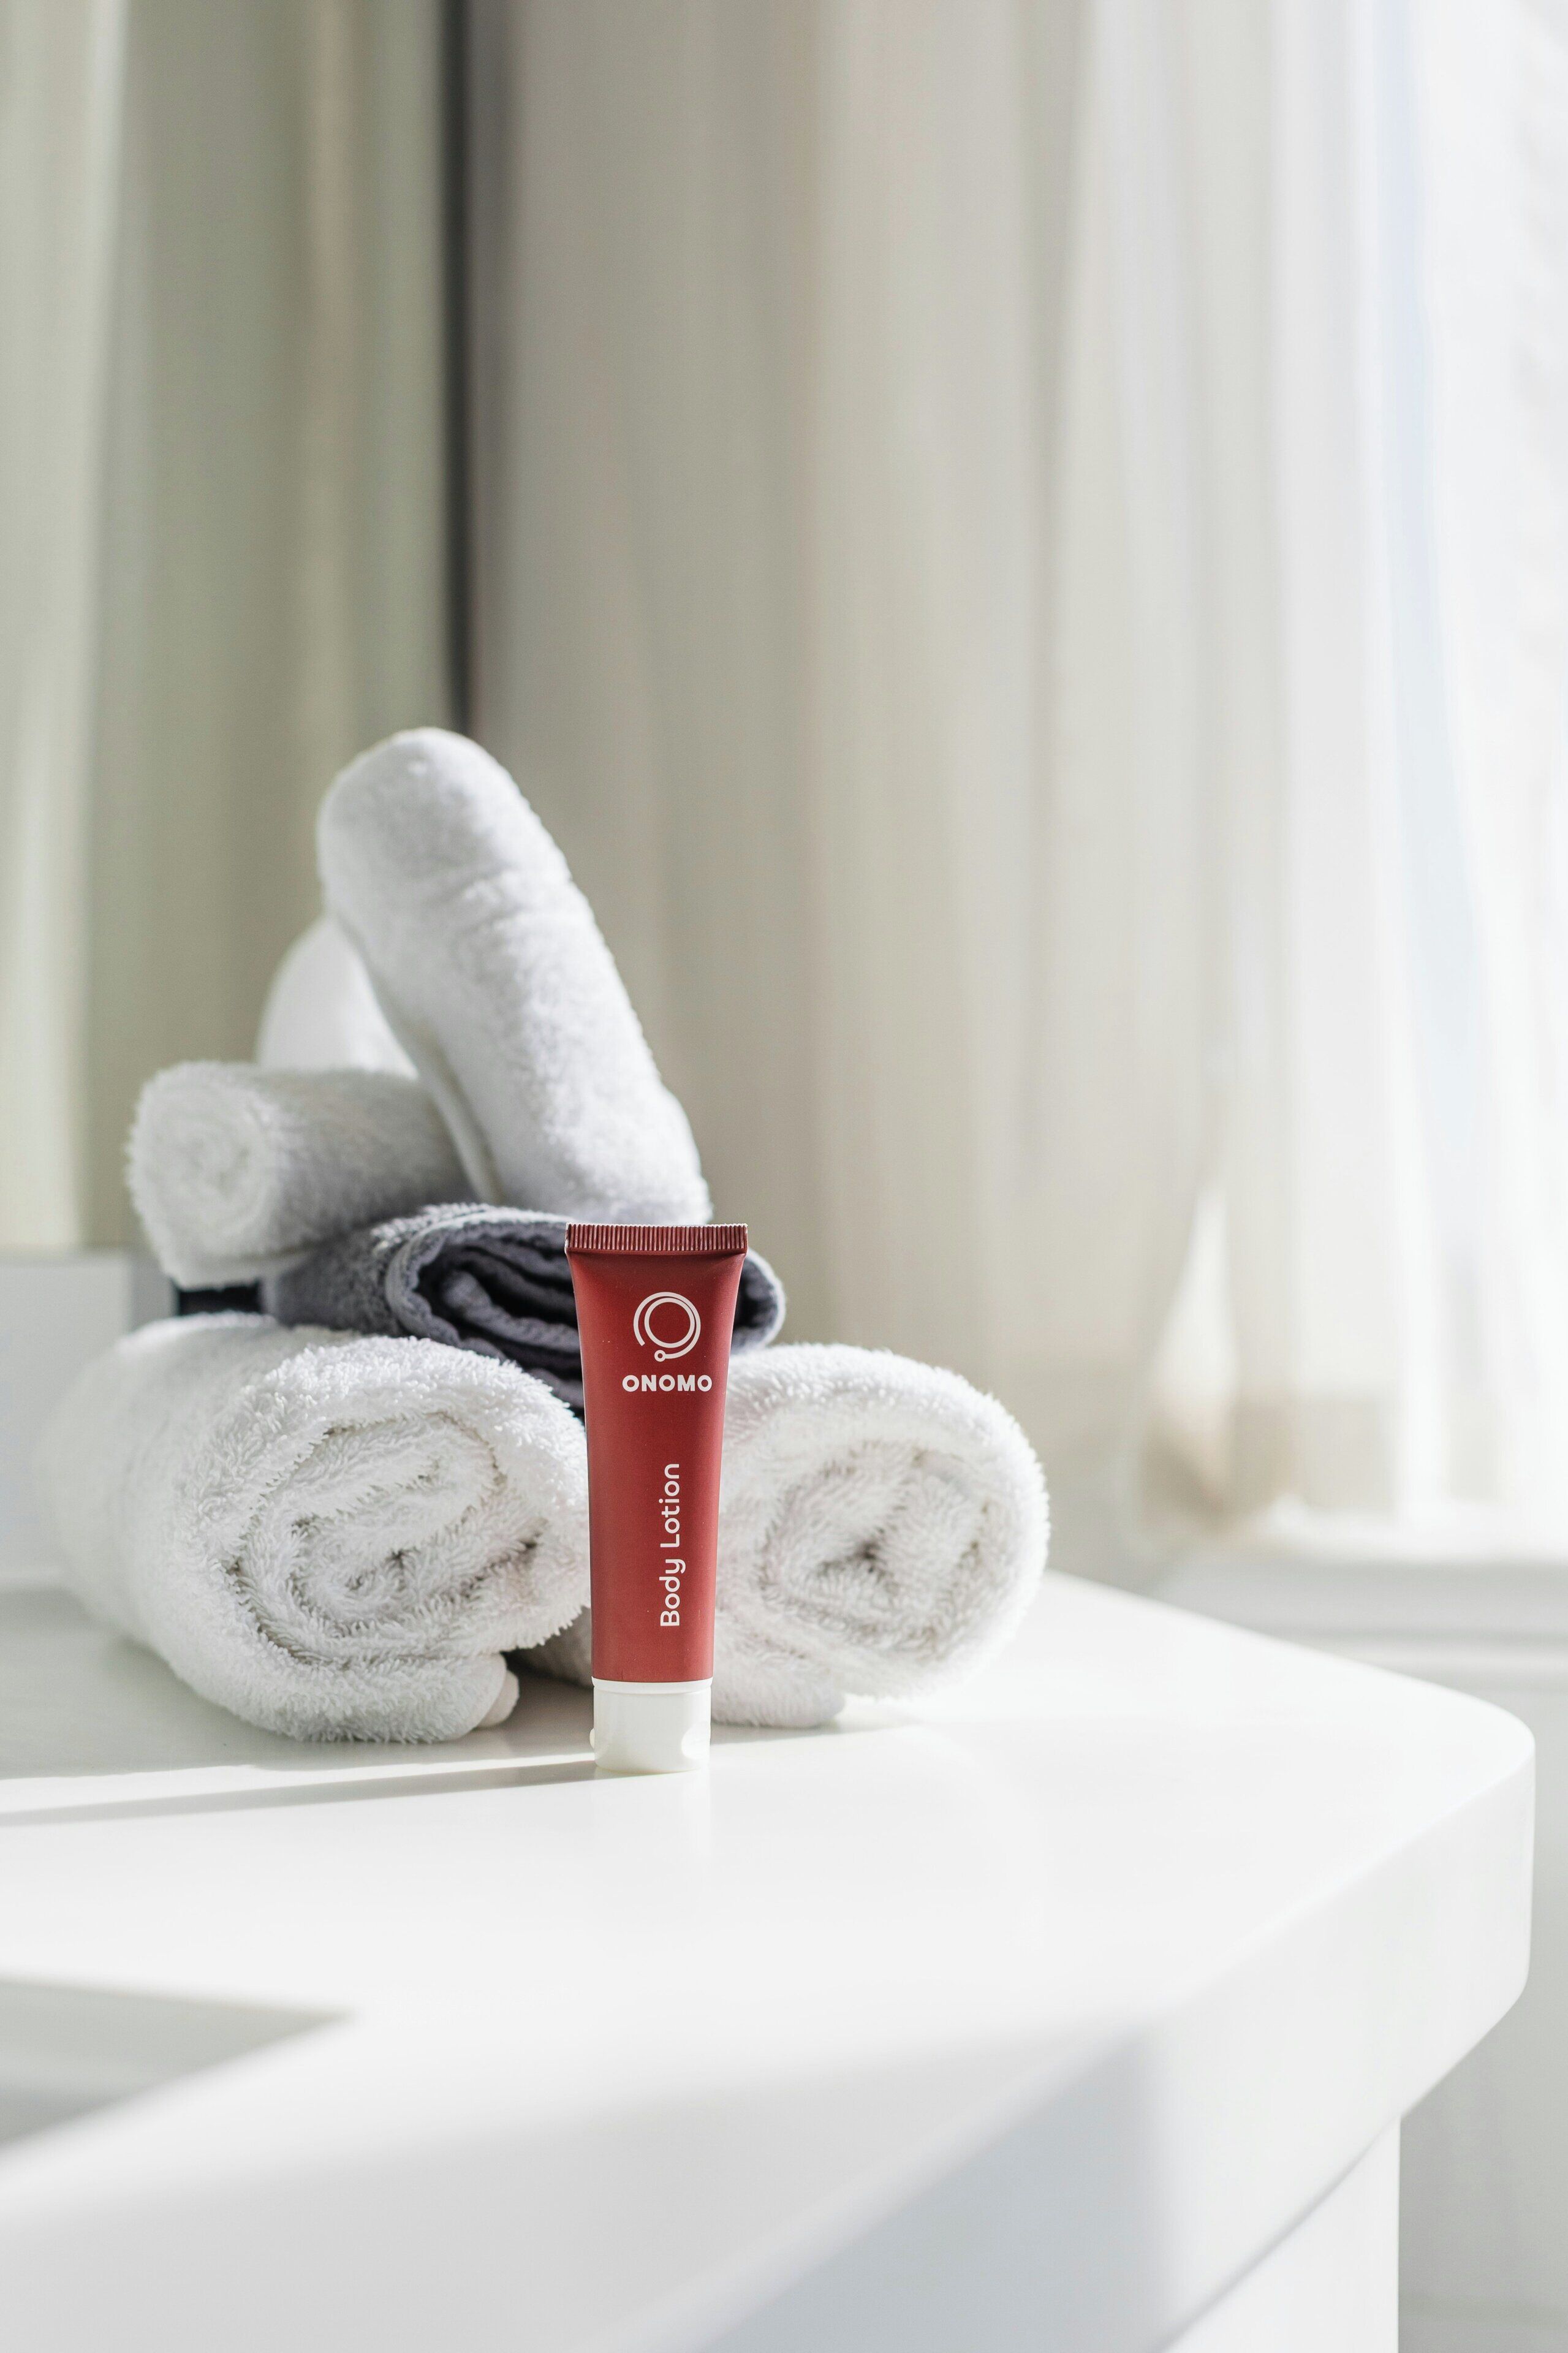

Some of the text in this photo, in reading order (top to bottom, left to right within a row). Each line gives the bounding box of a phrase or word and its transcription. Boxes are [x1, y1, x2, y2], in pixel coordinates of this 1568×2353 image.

[622, 1374, 713, 1392] ONOMO
[658, 1463, 686, 1627] Body Lotion
